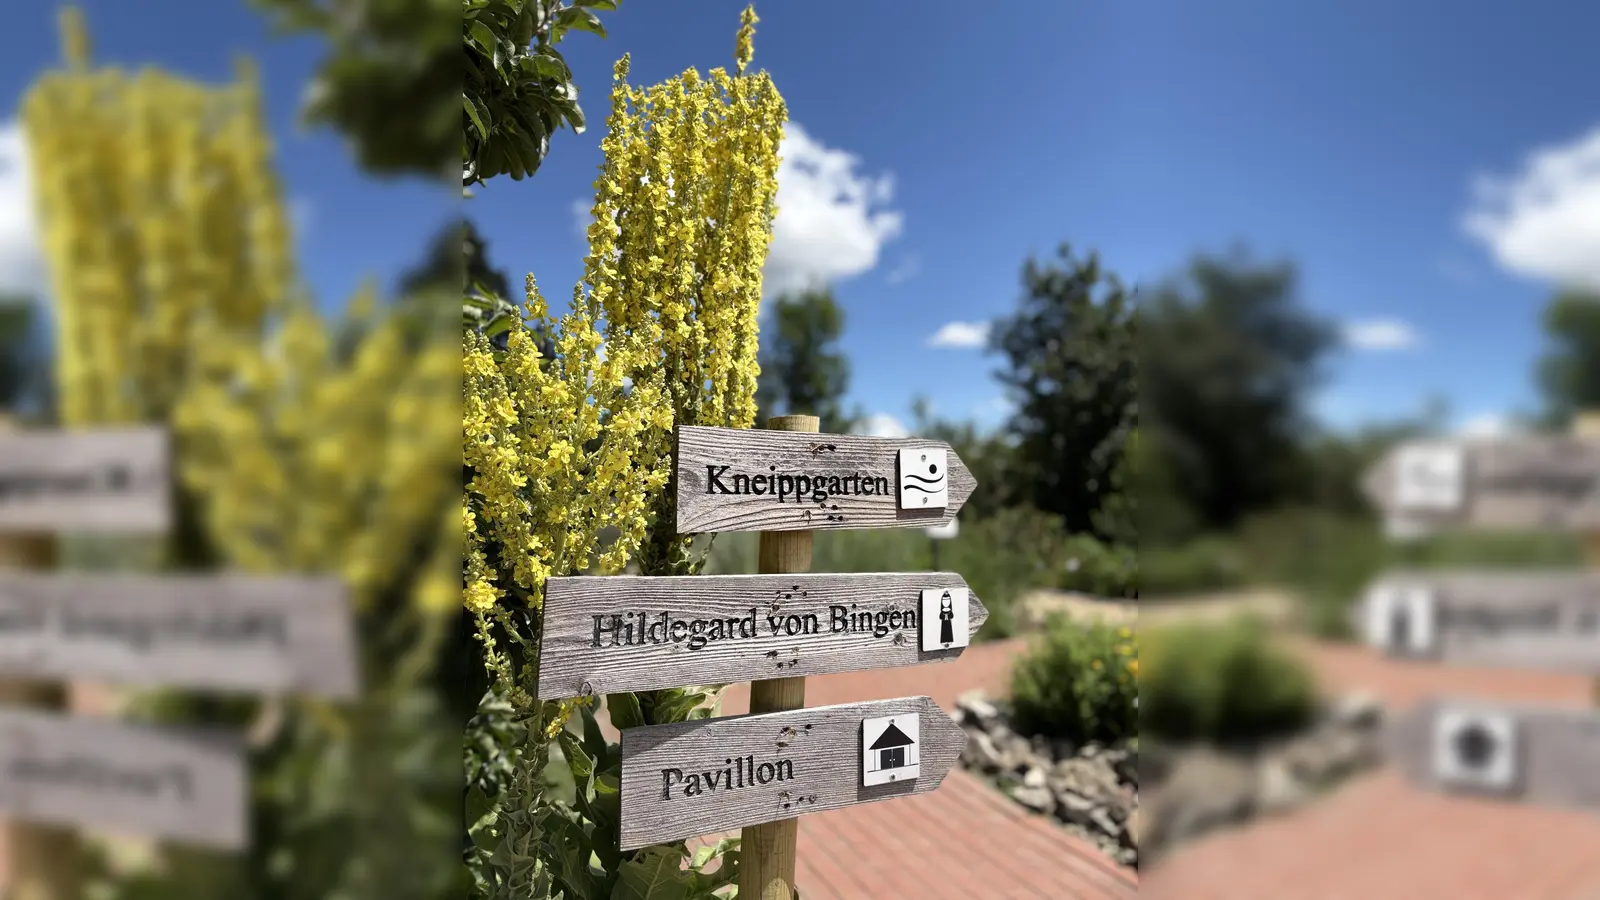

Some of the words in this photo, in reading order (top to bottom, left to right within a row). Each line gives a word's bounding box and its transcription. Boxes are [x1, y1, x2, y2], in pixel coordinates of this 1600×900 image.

[705, 464, 890, 503] Kneippgarten
[590, 607, 757, 650] Hildegard
[766, 609, 819, 637] von
[828, 604, 917, 638] Bingen
[660, 754, 795, 801] Pavillon
